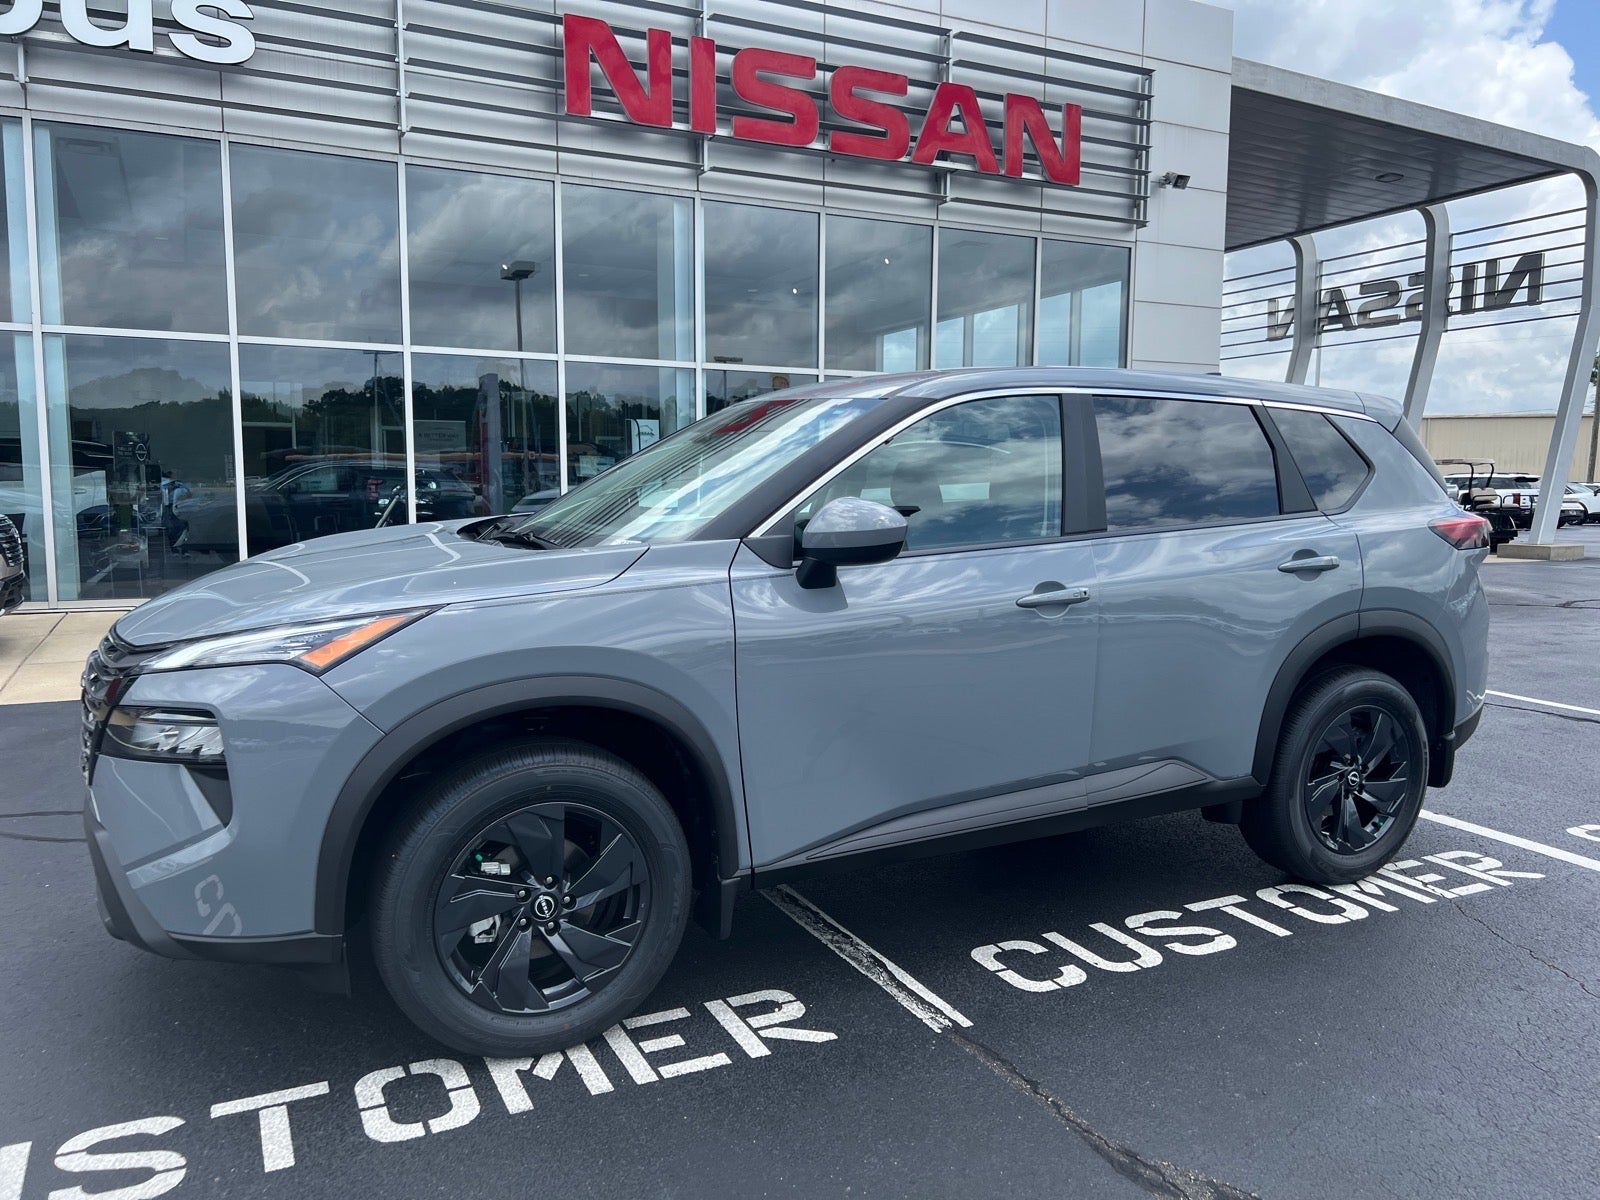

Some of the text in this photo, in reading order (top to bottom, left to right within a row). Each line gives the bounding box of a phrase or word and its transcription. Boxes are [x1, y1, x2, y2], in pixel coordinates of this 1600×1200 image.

[562, 14, 1082, 186] NISSAN
[971, 850, 1546, 993] CUSTOMER
[0, 988, 838, 1200] STOMER
